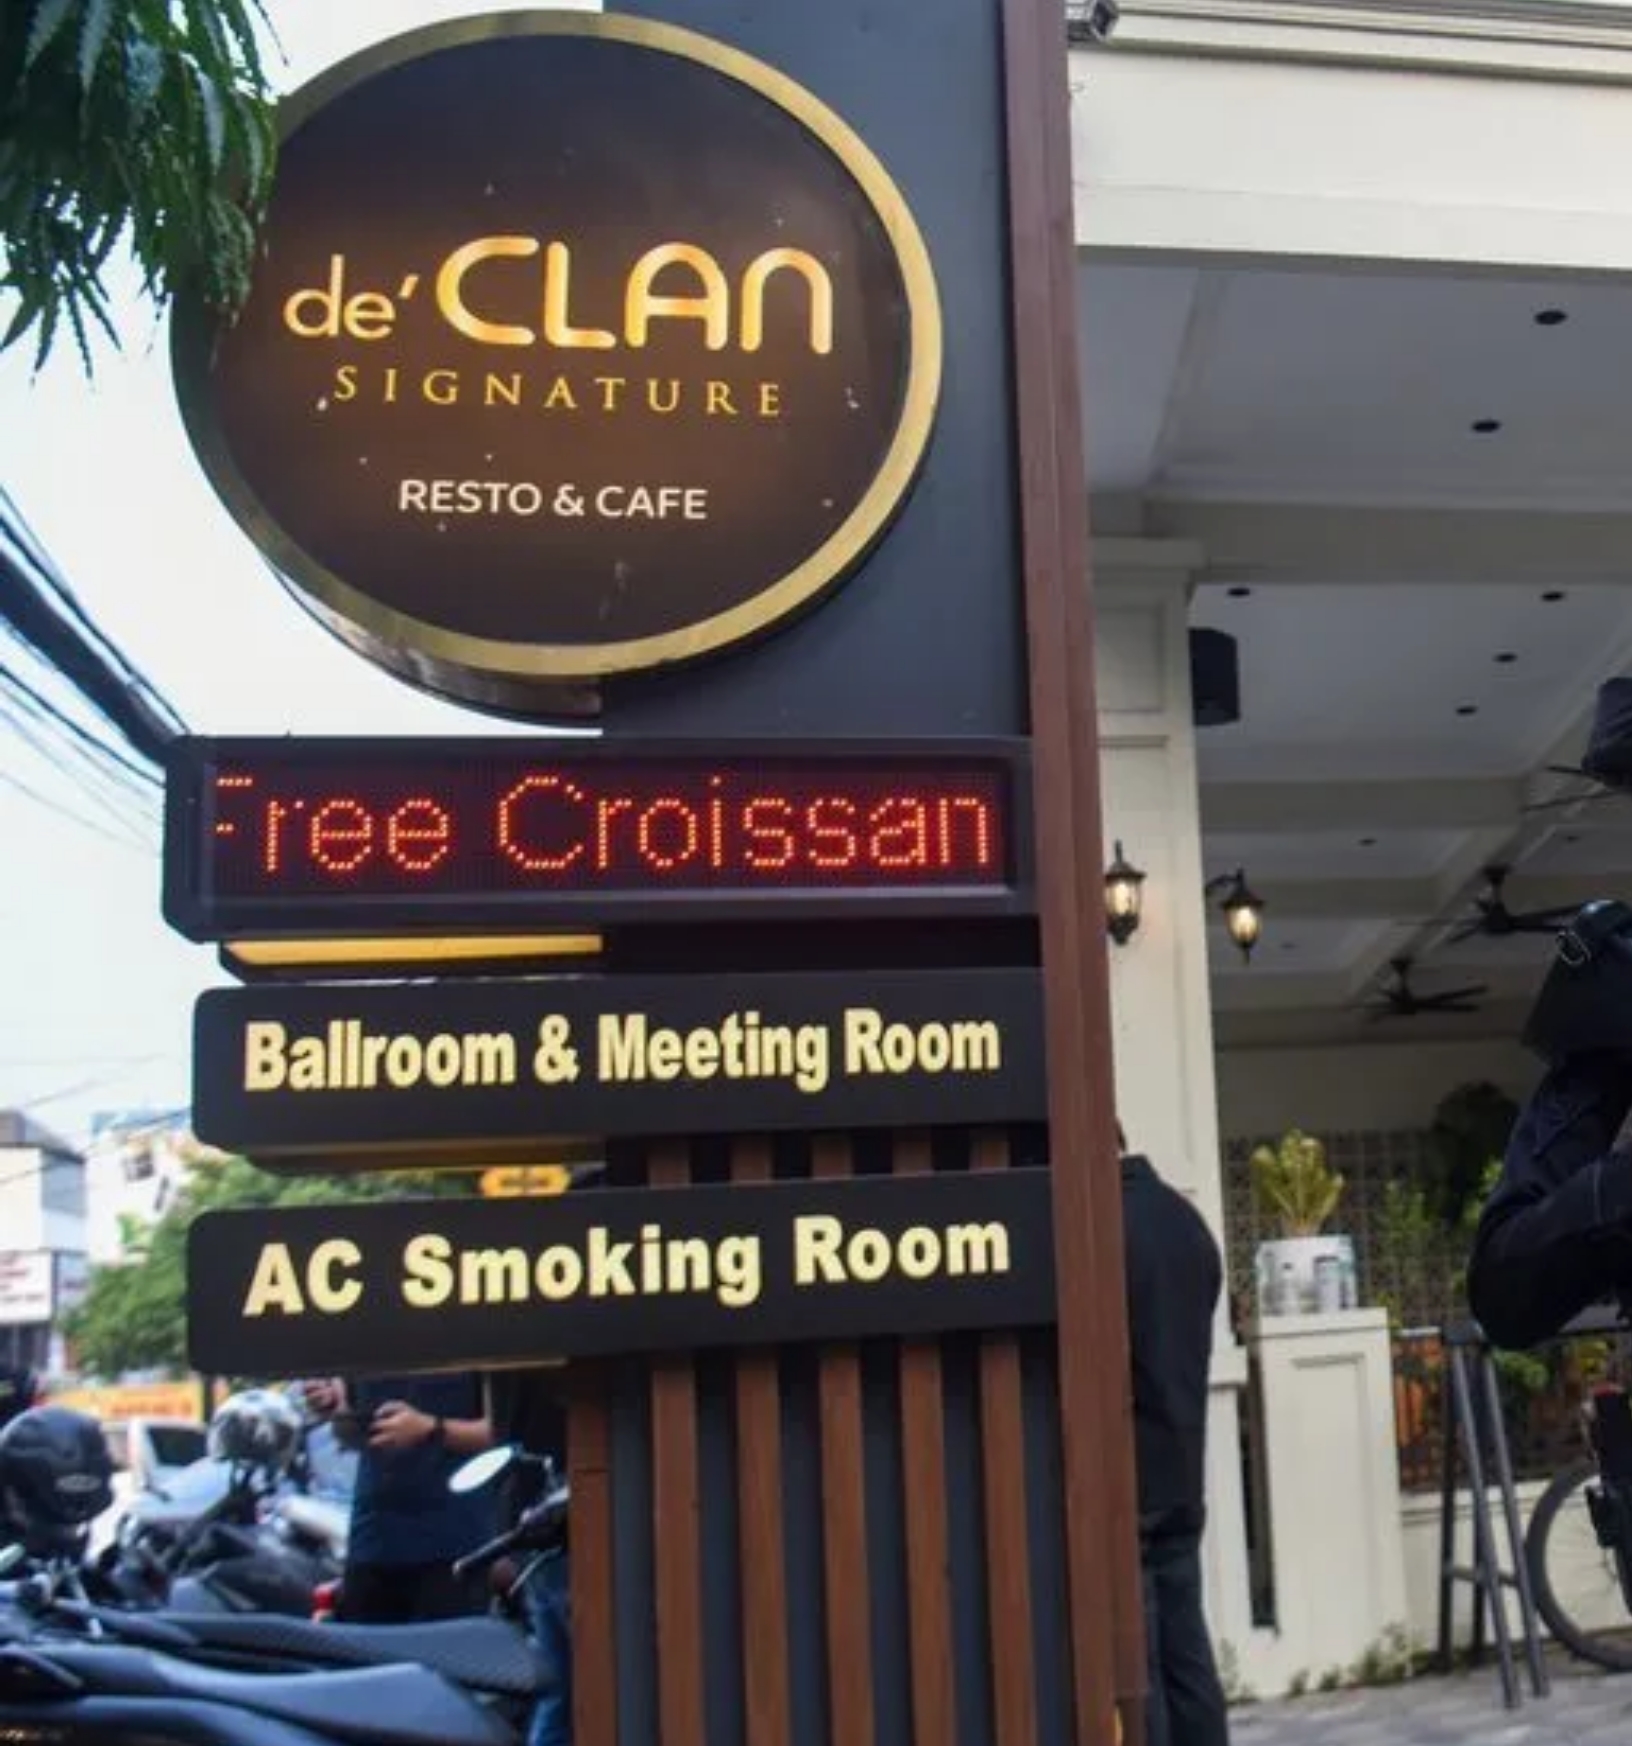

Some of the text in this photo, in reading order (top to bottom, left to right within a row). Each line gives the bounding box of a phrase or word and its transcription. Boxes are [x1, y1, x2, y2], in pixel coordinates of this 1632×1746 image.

[333, 364, 781, 416] SIGNATURE
[399, 479, 708, 520] RESTO & CAFE
[498, 774, 989, 871] Croissan
[244, 1008, 1000, 1092] Ballroom & Meeting Room
[243, 1214, 1009, 1316] AC Smoking Room
